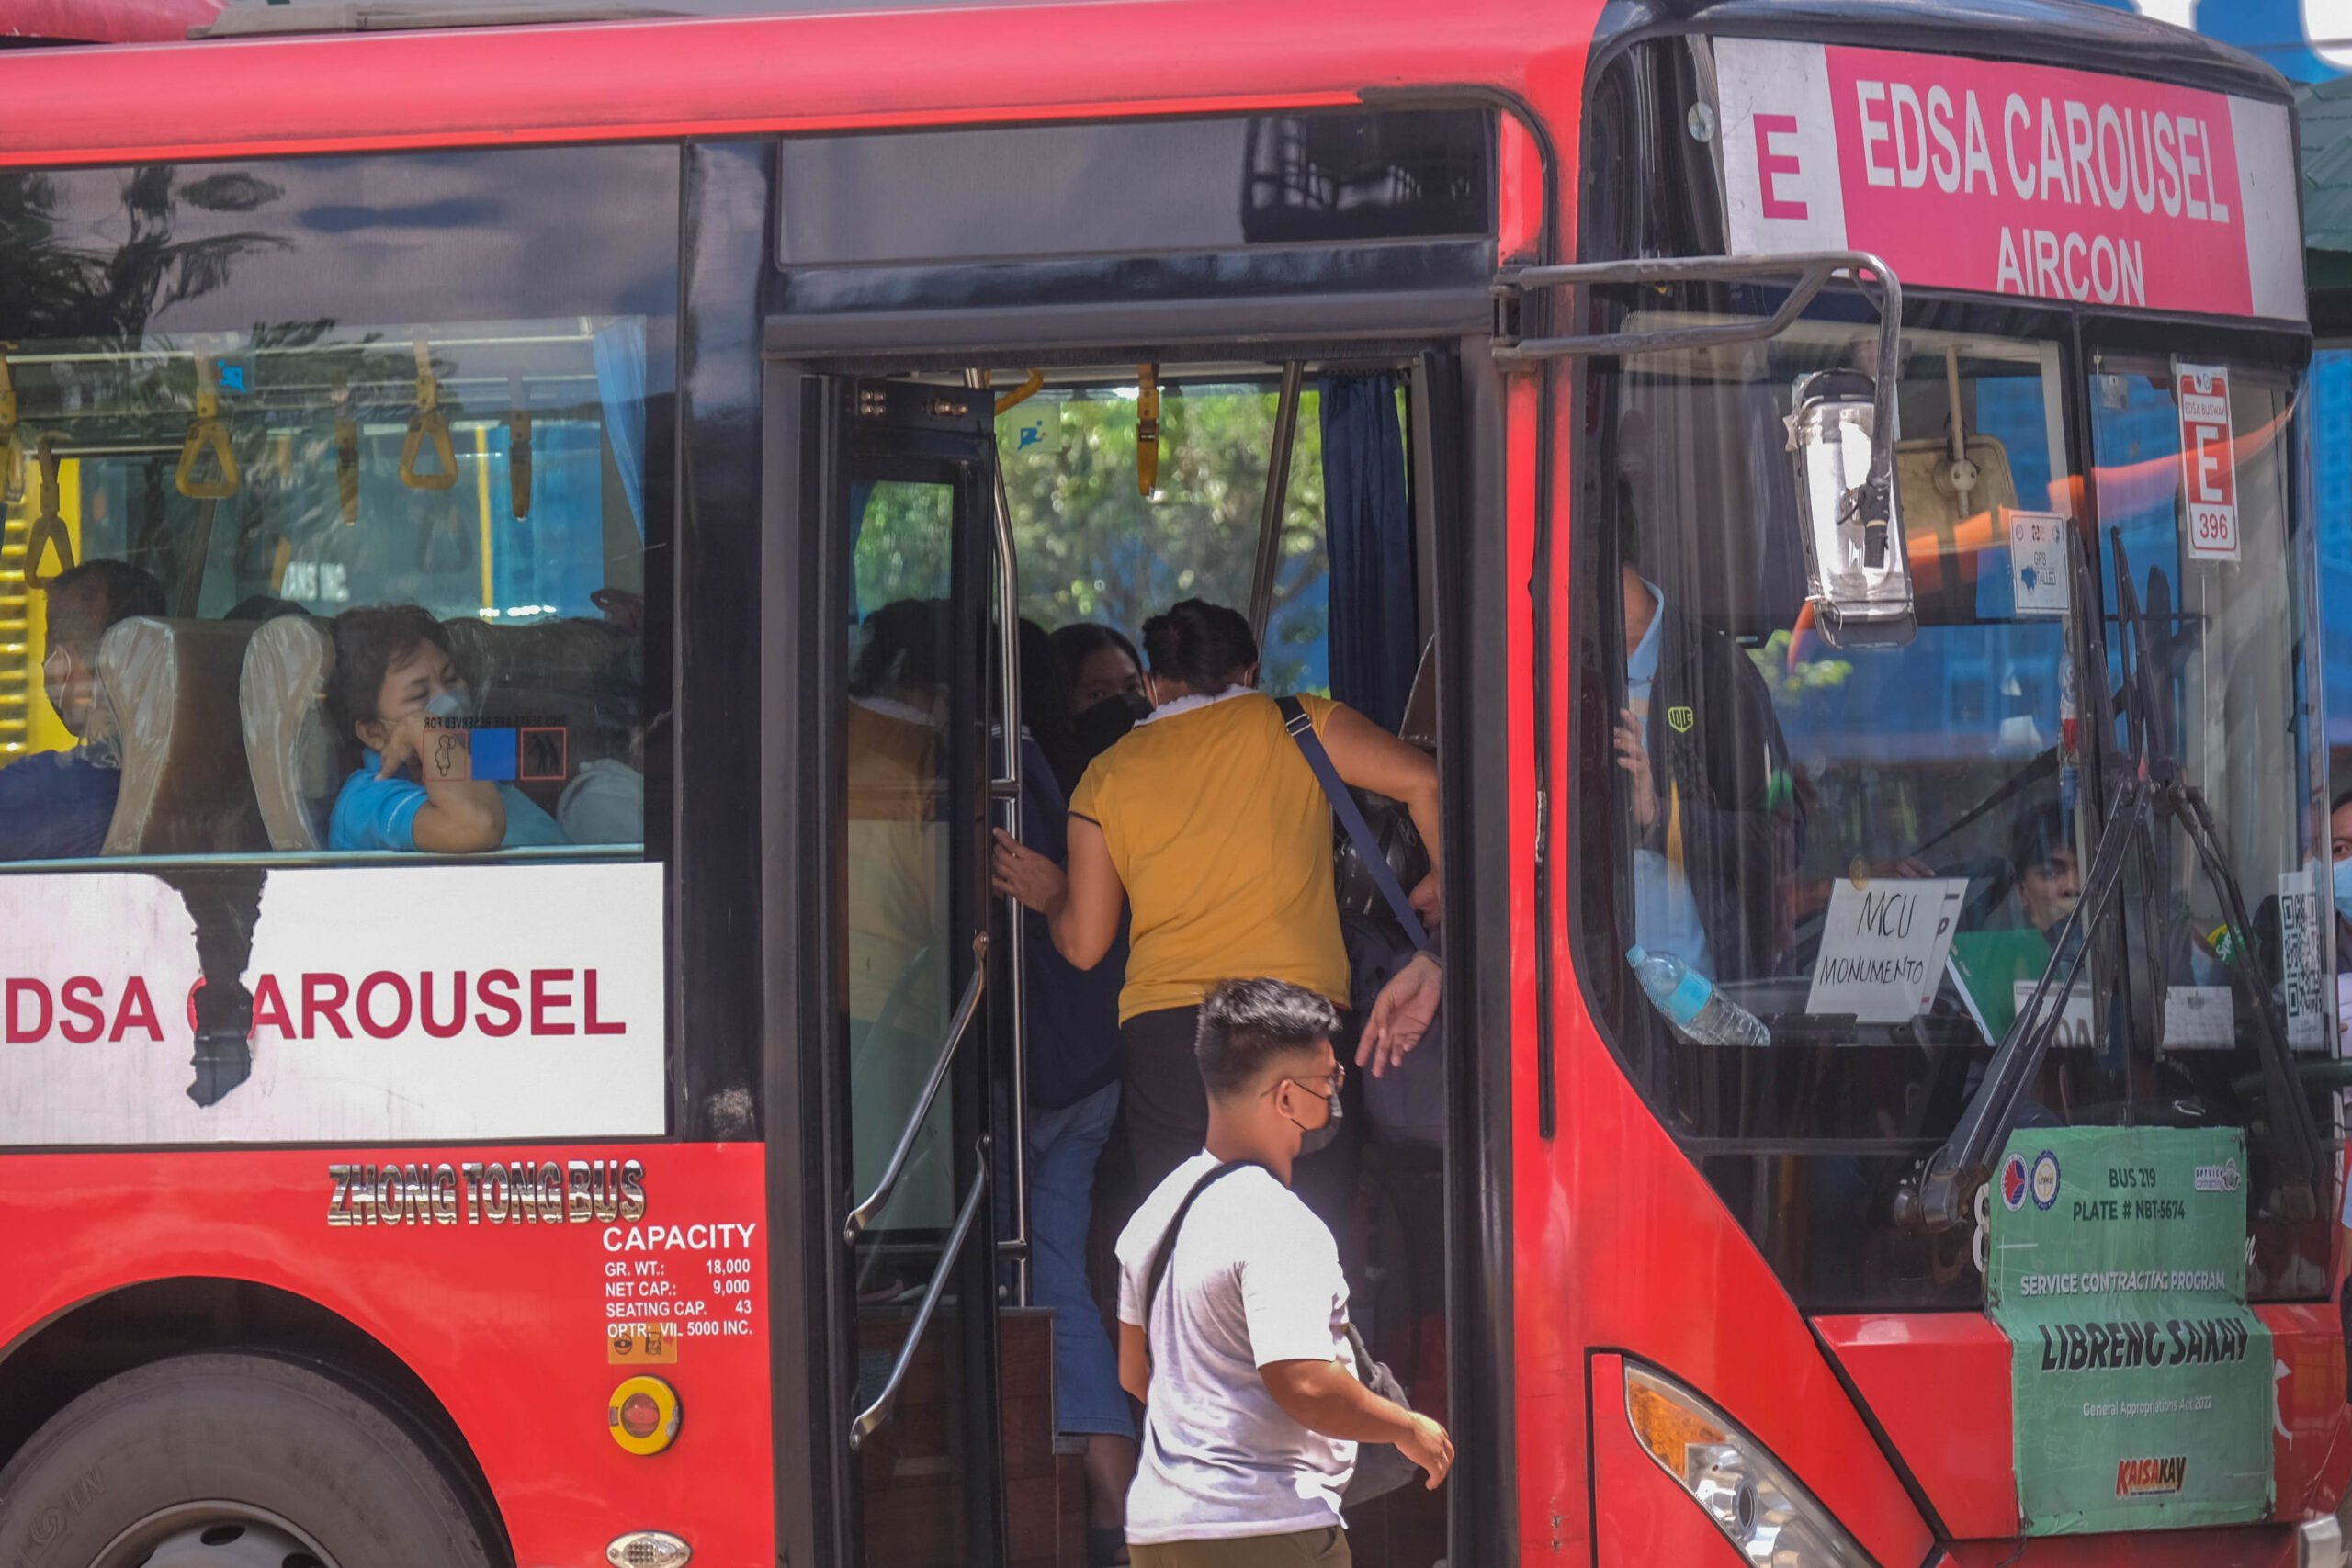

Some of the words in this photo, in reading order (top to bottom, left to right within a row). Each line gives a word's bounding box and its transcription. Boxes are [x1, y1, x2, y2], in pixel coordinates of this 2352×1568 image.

[1855, 79, 1998, 197] EDSA
[2003, 92, 2231, 224] CAROUSEL
[1753, 113, 1808, 220] E
[1996, 226, 2146, 308] AIRCON
[2185, 402, 2201, 416] EDSA
[2195, 424, 2223, 502] E
[2199, 513, 2229, 540] 396
[2033, 550, 2047, 567] GPS
[1856, 890, 1917, 940] MCU
[1819, 955, 1925, 987] MONUMENTO
[187, 968, 627, 1043] AROUSEL
[327, 1161, 458, 1227] ZHONG
[461, 1160, 563, 1225] TONG
[567, 1158, 646, 1224] BUS
[2109, 1168, 2137, 1189] BUS
[2138, 1168, 2156, 1188] 219
[2073, 1201, 2118, 1222] PLATE
[2122, 1201, 2132, 1220] #
[2135, 1200, 2186, 1220] NBT-5674
[603, 1223, 756, 1252] CAPACITY
[605, 1261, 631, 1277] GR.
[634, 1260, 665, 1276] WT.:
[706, 1258, 751, 1275] 18,000
[605, 1281, 635, 1297] NET
[639, 1280, 676, 1297] CAP.:
[713, 1279, 750, 1297] 9,000
[2020, 1273, 2078, 1297] SERVICE
[2080, 1269, 2170, 1293] CONTRACTING
[2170, 1270, 2226, 1293] PROGRAM
[605, 1301, 670, 1318] SEATING
[673, 1300, 707, 1316] CAP.
[735, 1299, 752, 1314] 43
[686, 1321, 719, 1336] 5000
[723, 1320, 752, 1335] INC.
[2038, 1320, 2165, 1372] LIBRENG
[2166, 1317, 2249, 1367] SAKAY
[2083, 1401, 2119, 1416] General
[2120, 1398, 2177, 1417] Appropriations
[2178, 1397, 2194, 1412] Act
[2194, 1395, 2212, 1410] 2022
